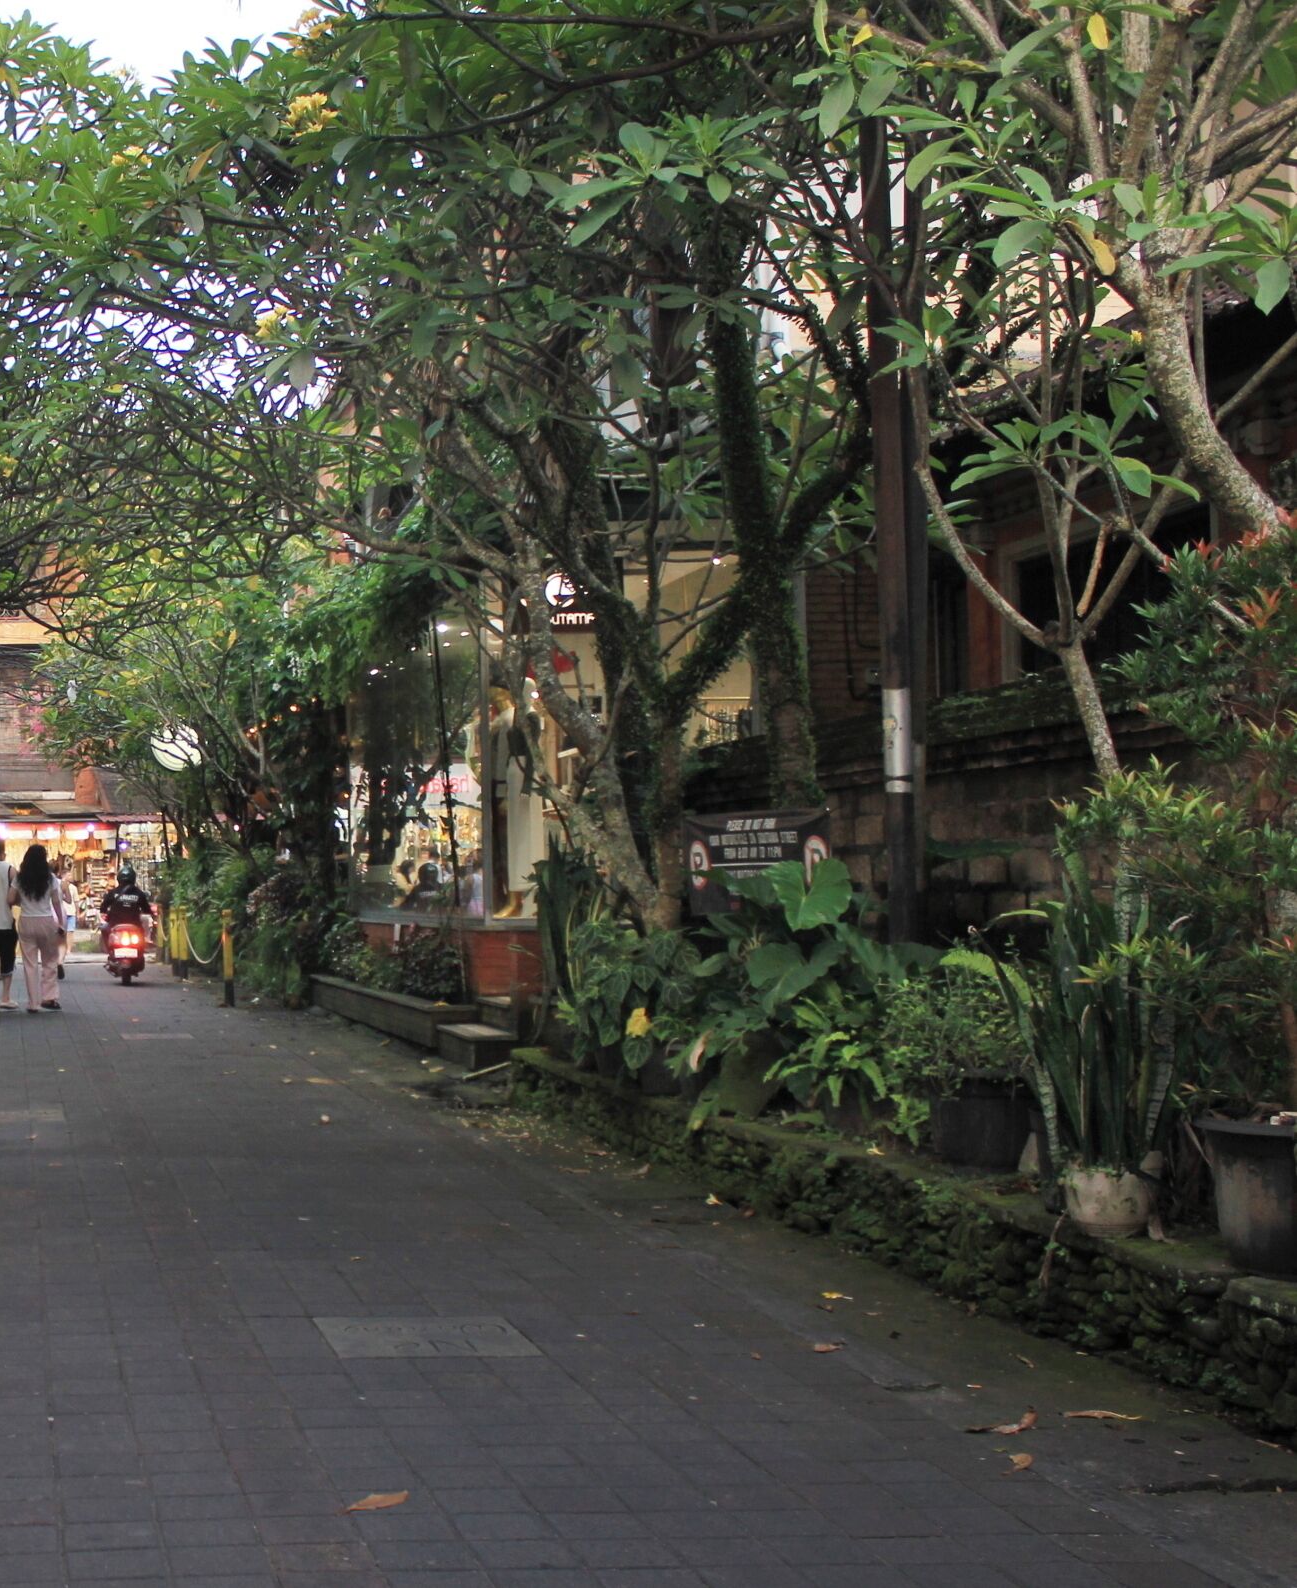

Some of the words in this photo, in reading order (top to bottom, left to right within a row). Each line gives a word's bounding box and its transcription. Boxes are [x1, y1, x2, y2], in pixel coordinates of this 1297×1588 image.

[726, 820, 744, 831] PLEASE
[762, 818, 777, 829] PARK
[779, 831, 798, 843] STREET
[724, 847, 736, 859] FROM
